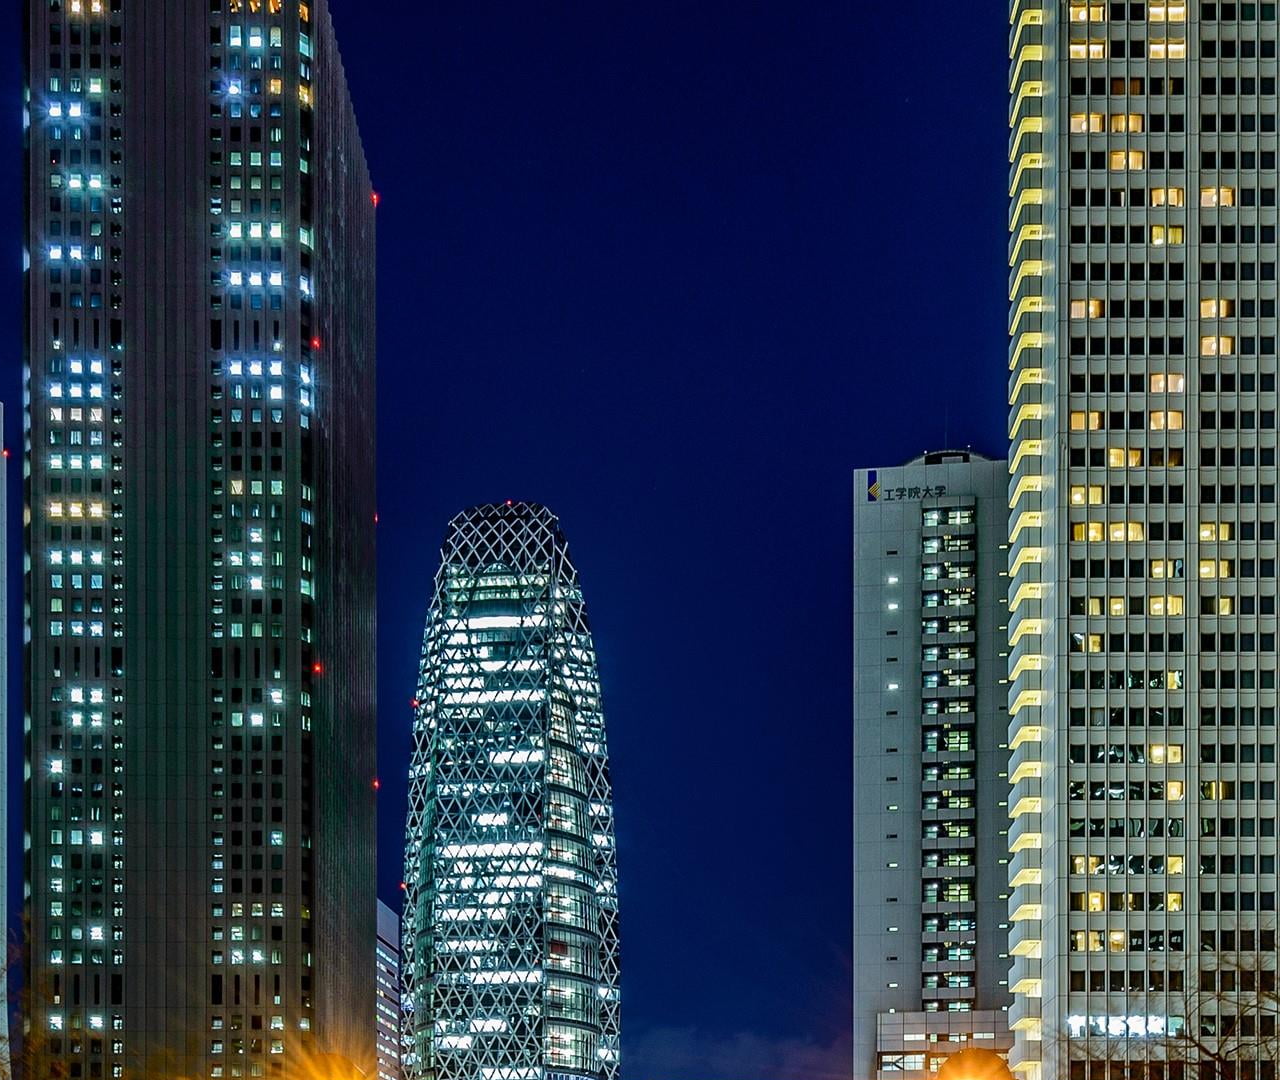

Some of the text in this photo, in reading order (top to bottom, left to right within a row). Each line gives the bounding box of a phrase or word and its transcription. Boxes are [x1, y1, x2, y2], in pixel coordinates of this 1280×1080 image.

[884, 485, 946, 501] 工学院大学
